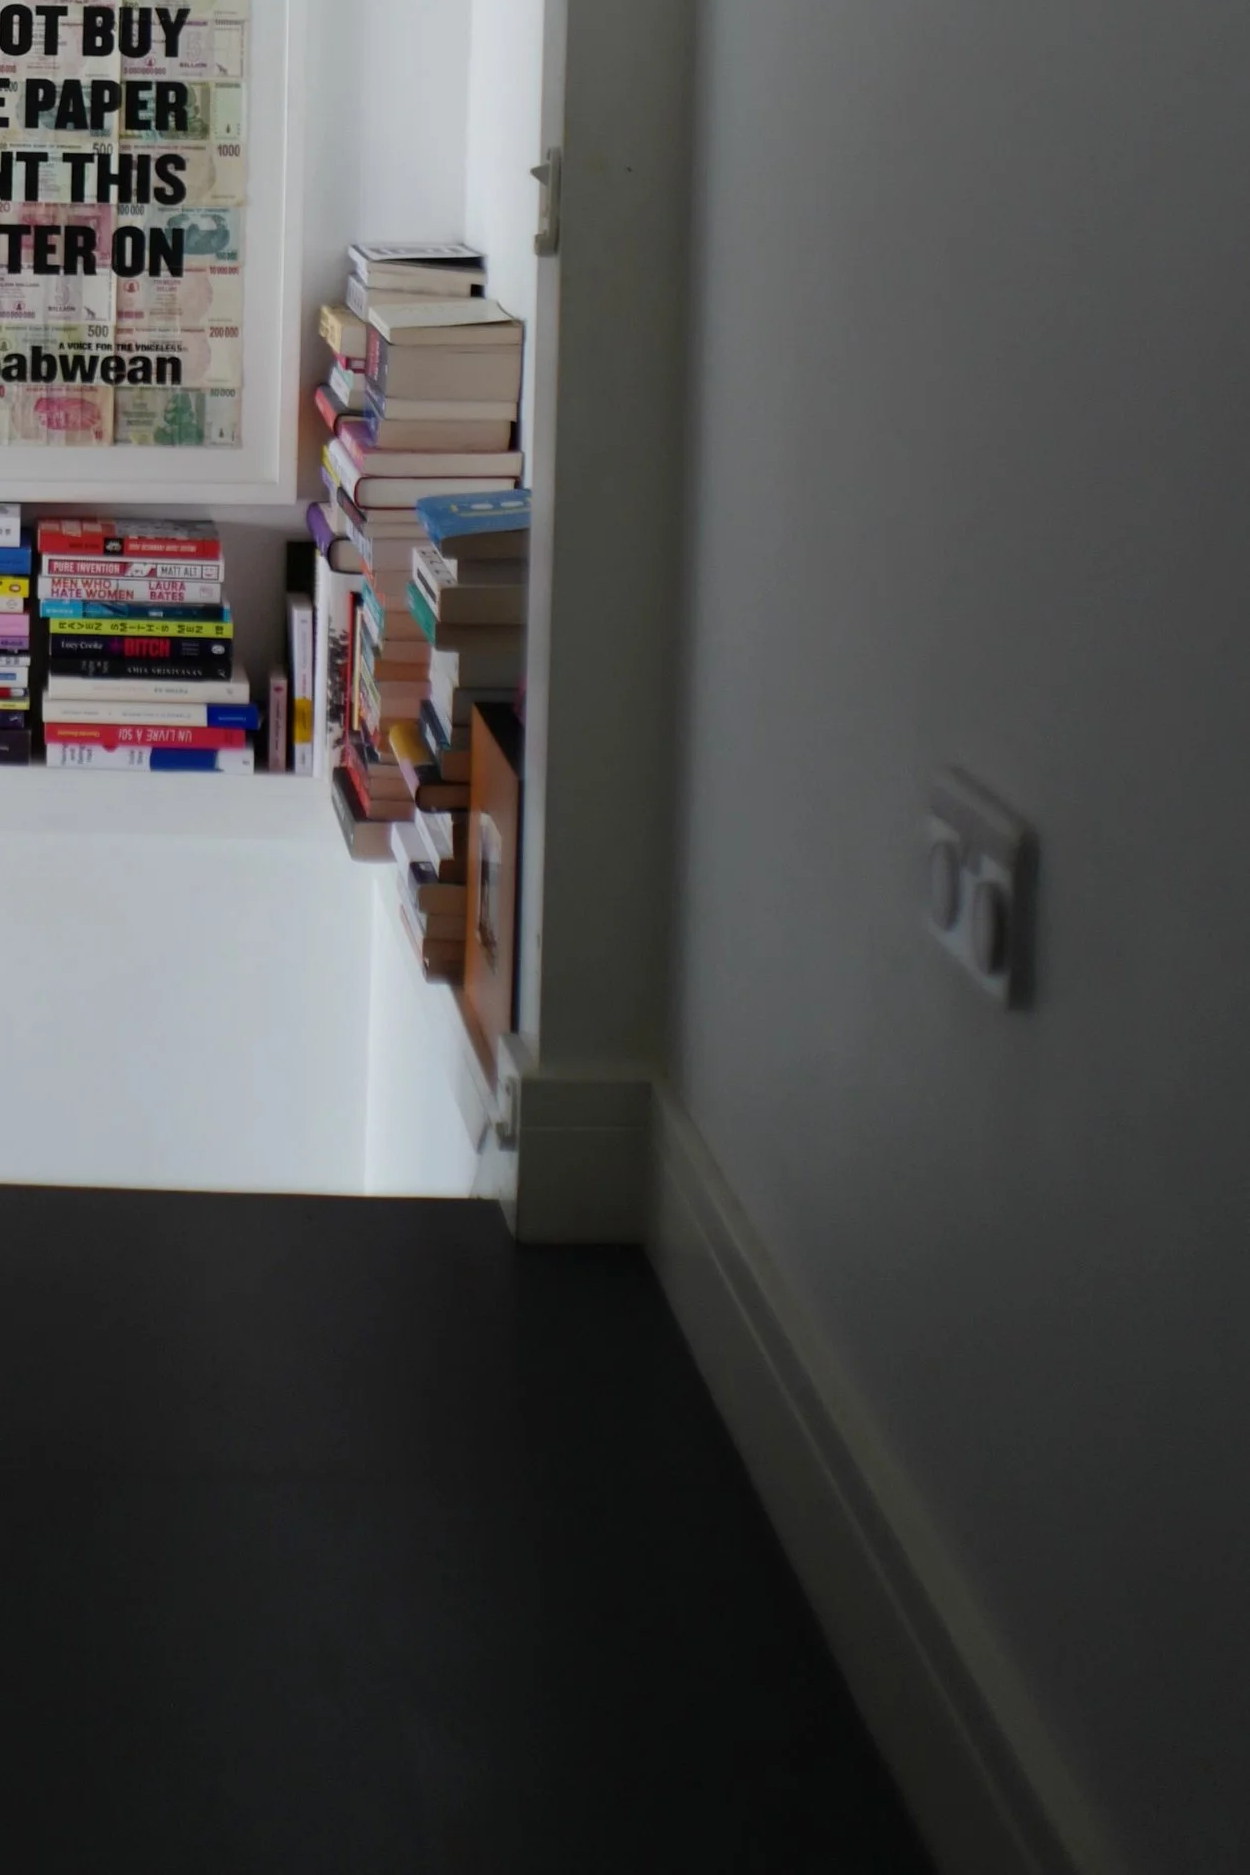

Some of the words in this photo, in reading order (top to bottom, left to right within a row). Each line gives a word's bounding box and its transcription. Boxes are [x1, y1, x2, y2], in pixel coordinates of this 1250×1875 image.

[82, 5, 191, 58] BUY
[25, 78, 189, 132] PAPER
[217, 144, 241, 157] 1000
[62, 151, 187, 206] THIS
[111, 225, 184, 278] ON
[87, 325, 108, 338] 500
[59, 342, 65, 350] A
[68, 342, 93, 351] VOICE
[96, 343, 112, 351] FOR
[116, 343, 133, 352] THE
[135, 343, 182, 353] VOICELESS
[53, 562, 75, 574] PURE
[76, 562, 120, 575] INVENTION
[161, 565, 181, 576] MATT
[183, 566, 197, 577] ALT
[51, 578, 79, 588] MEN
[81, 579, 112, 589] WHO
[148, 581, 187, 591] LAURA
[50, 588, 82, 599] HATE
[85, 589, 134, 600] WOMEN
[150, 590, 185, 601] BATES
[58, 622, 102, 631] RAVEN
[61, 641, 78, 651] Lucy
[124, 637, 170, 658] BITCH
[146, 728, 177, 742] LIVRE
[178, 731, 192, 743] UN
